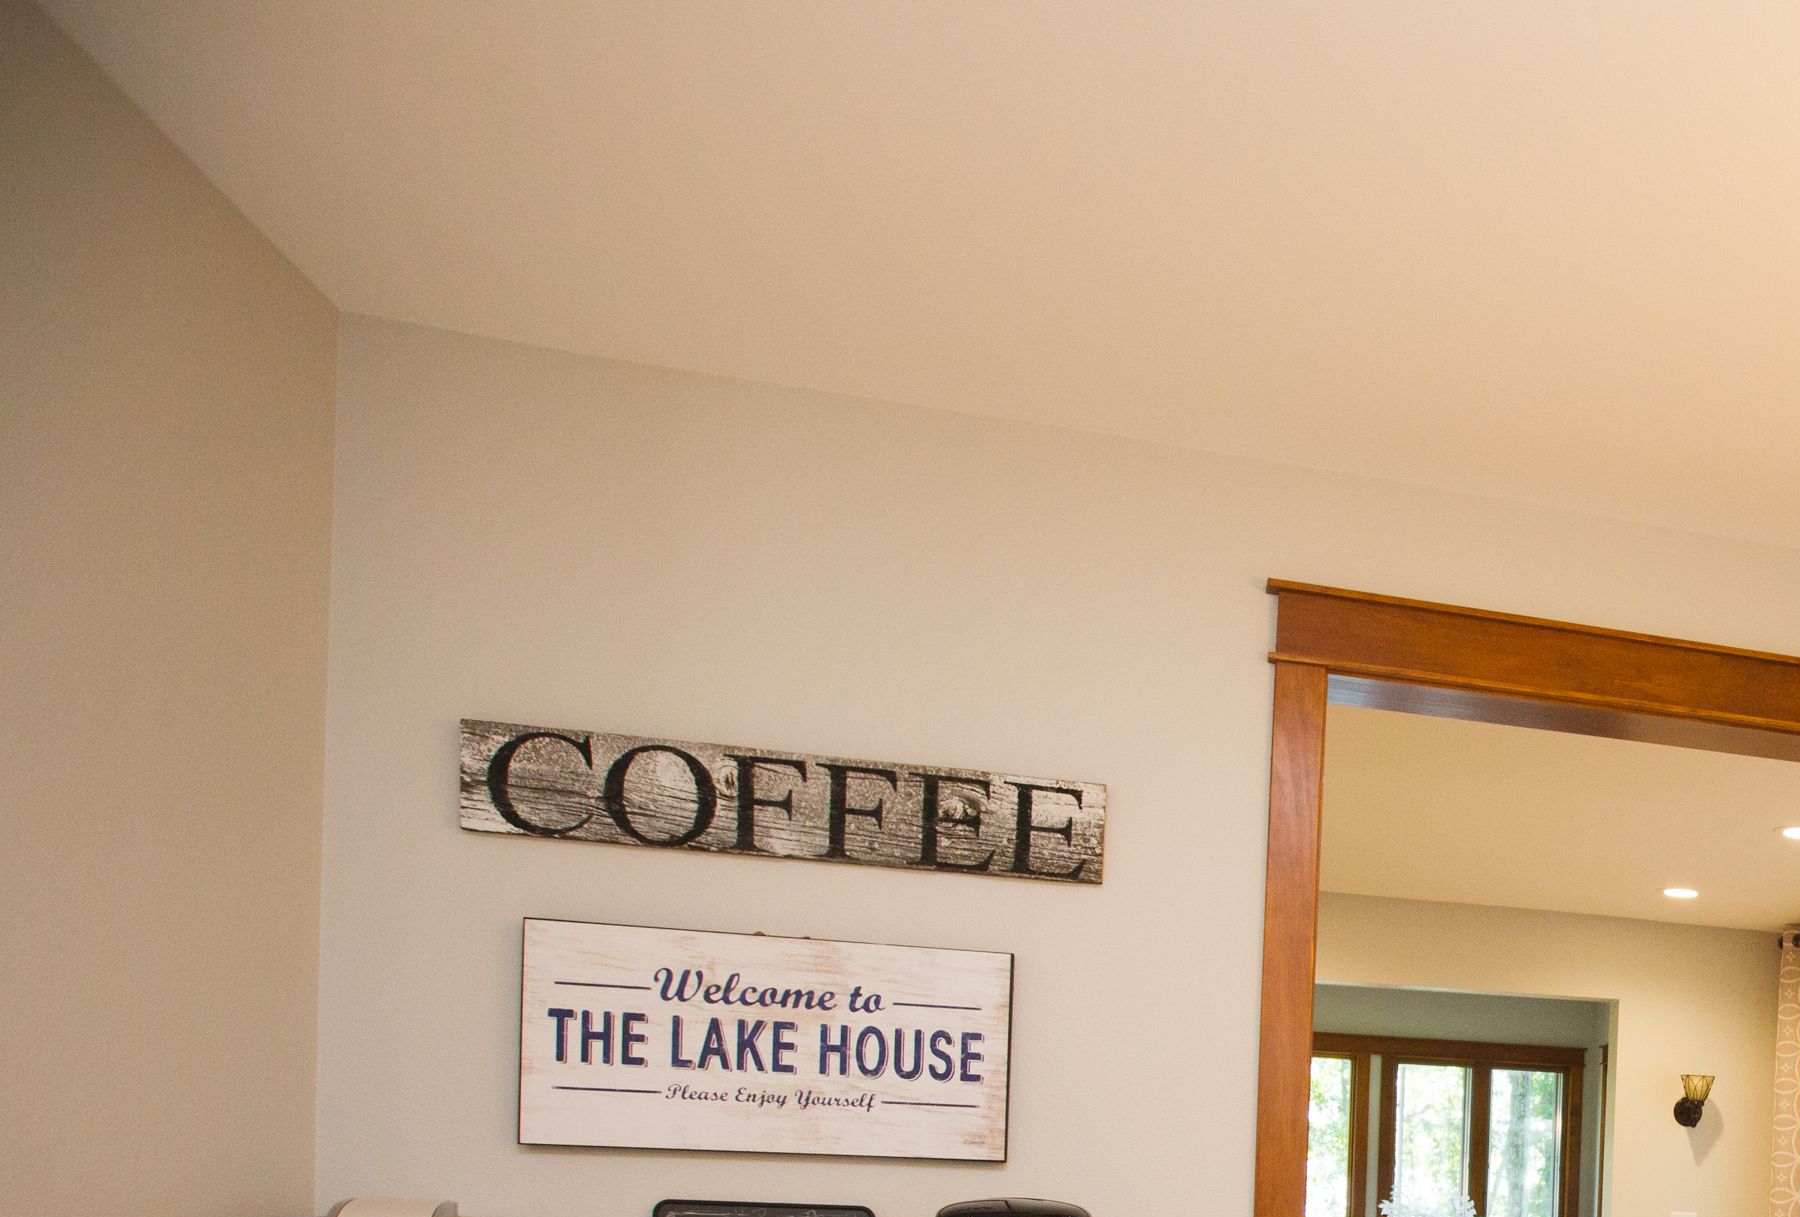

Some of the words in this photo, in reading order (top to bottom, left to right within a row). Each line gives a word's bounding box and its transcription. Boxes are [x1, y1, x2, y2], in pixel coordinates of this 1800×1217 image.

[487, 731, 1087, 881] COFFEE
[653, 967, 838, 1012] Welcome
[848, 985, 886, 1014] to
[547, 1007, 649, 1068] THE
[671, 1015, 799, 1075] LAKE
[818, 1023, 985, 1084] HOUSE
[664, 1083, 729, 1102] Please
[735, 1087, 788, 1110] Enjoy
[794, 1089, 878, 1113] Yourself
